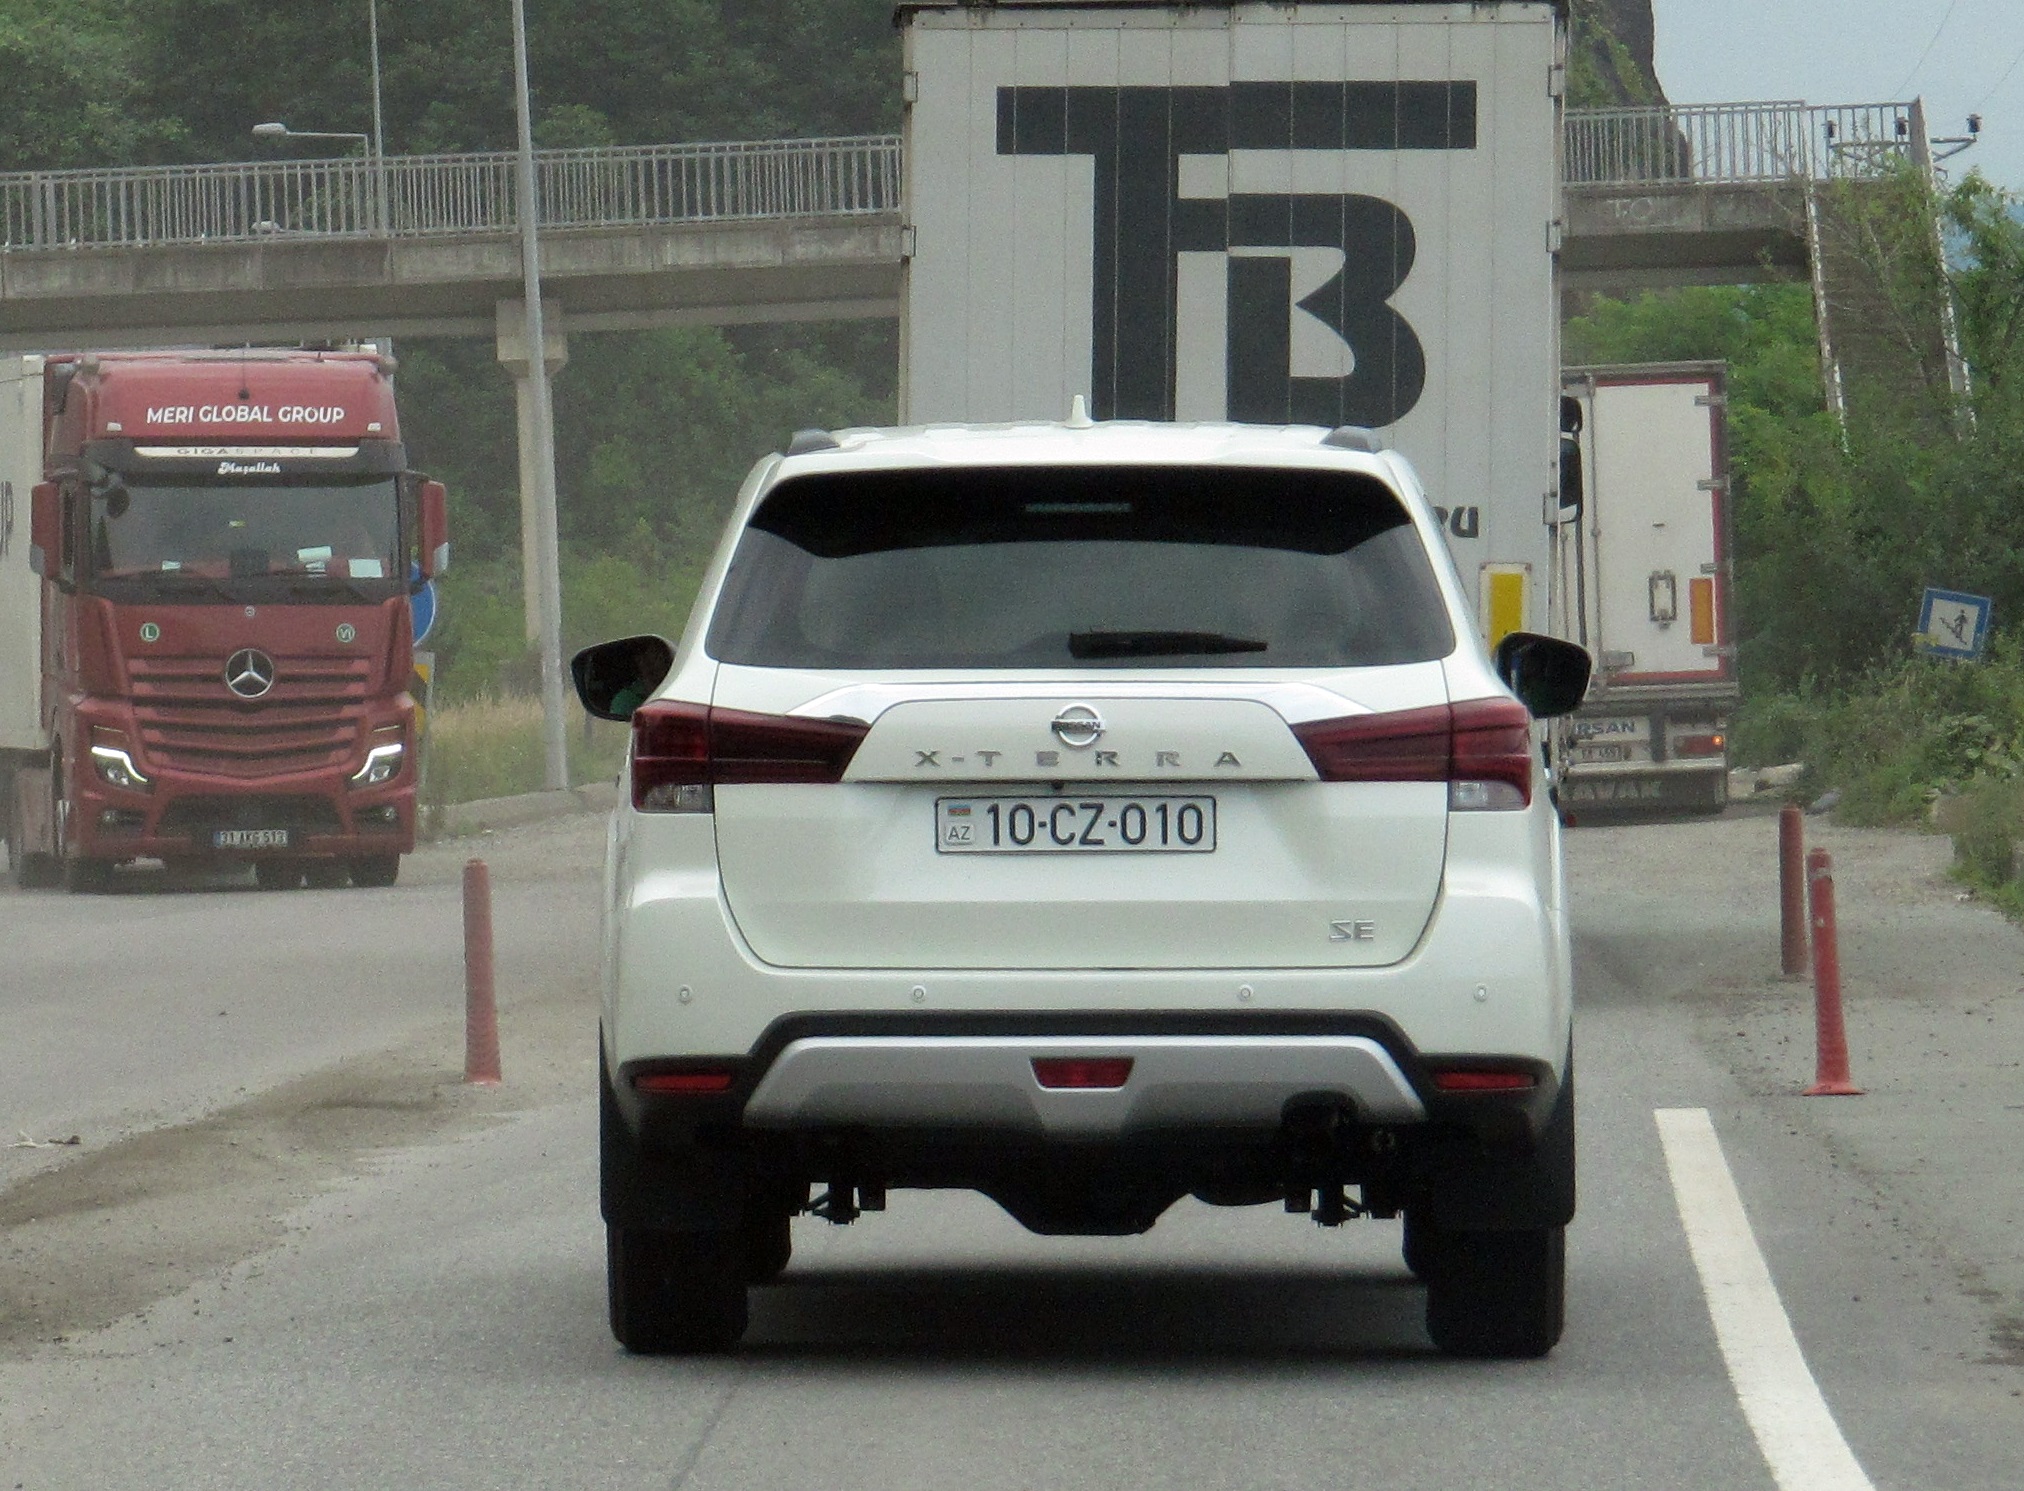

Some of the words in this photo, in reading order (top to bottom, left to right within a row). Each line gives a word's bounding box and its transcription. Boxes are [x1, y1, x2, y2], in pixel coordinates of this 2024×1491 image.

[147, 407, 194, 424] MERI
[199, 405, 273, 422] GLOBAL
[278, 406, 345, 424] GROUP
[915, 750, 1241, 768] X-TERRA
[948, 825, 971, 841] AZ
[987, 803, 1204, 845] 10-CZ-010
[1329, 919, 1375, 941] SE
